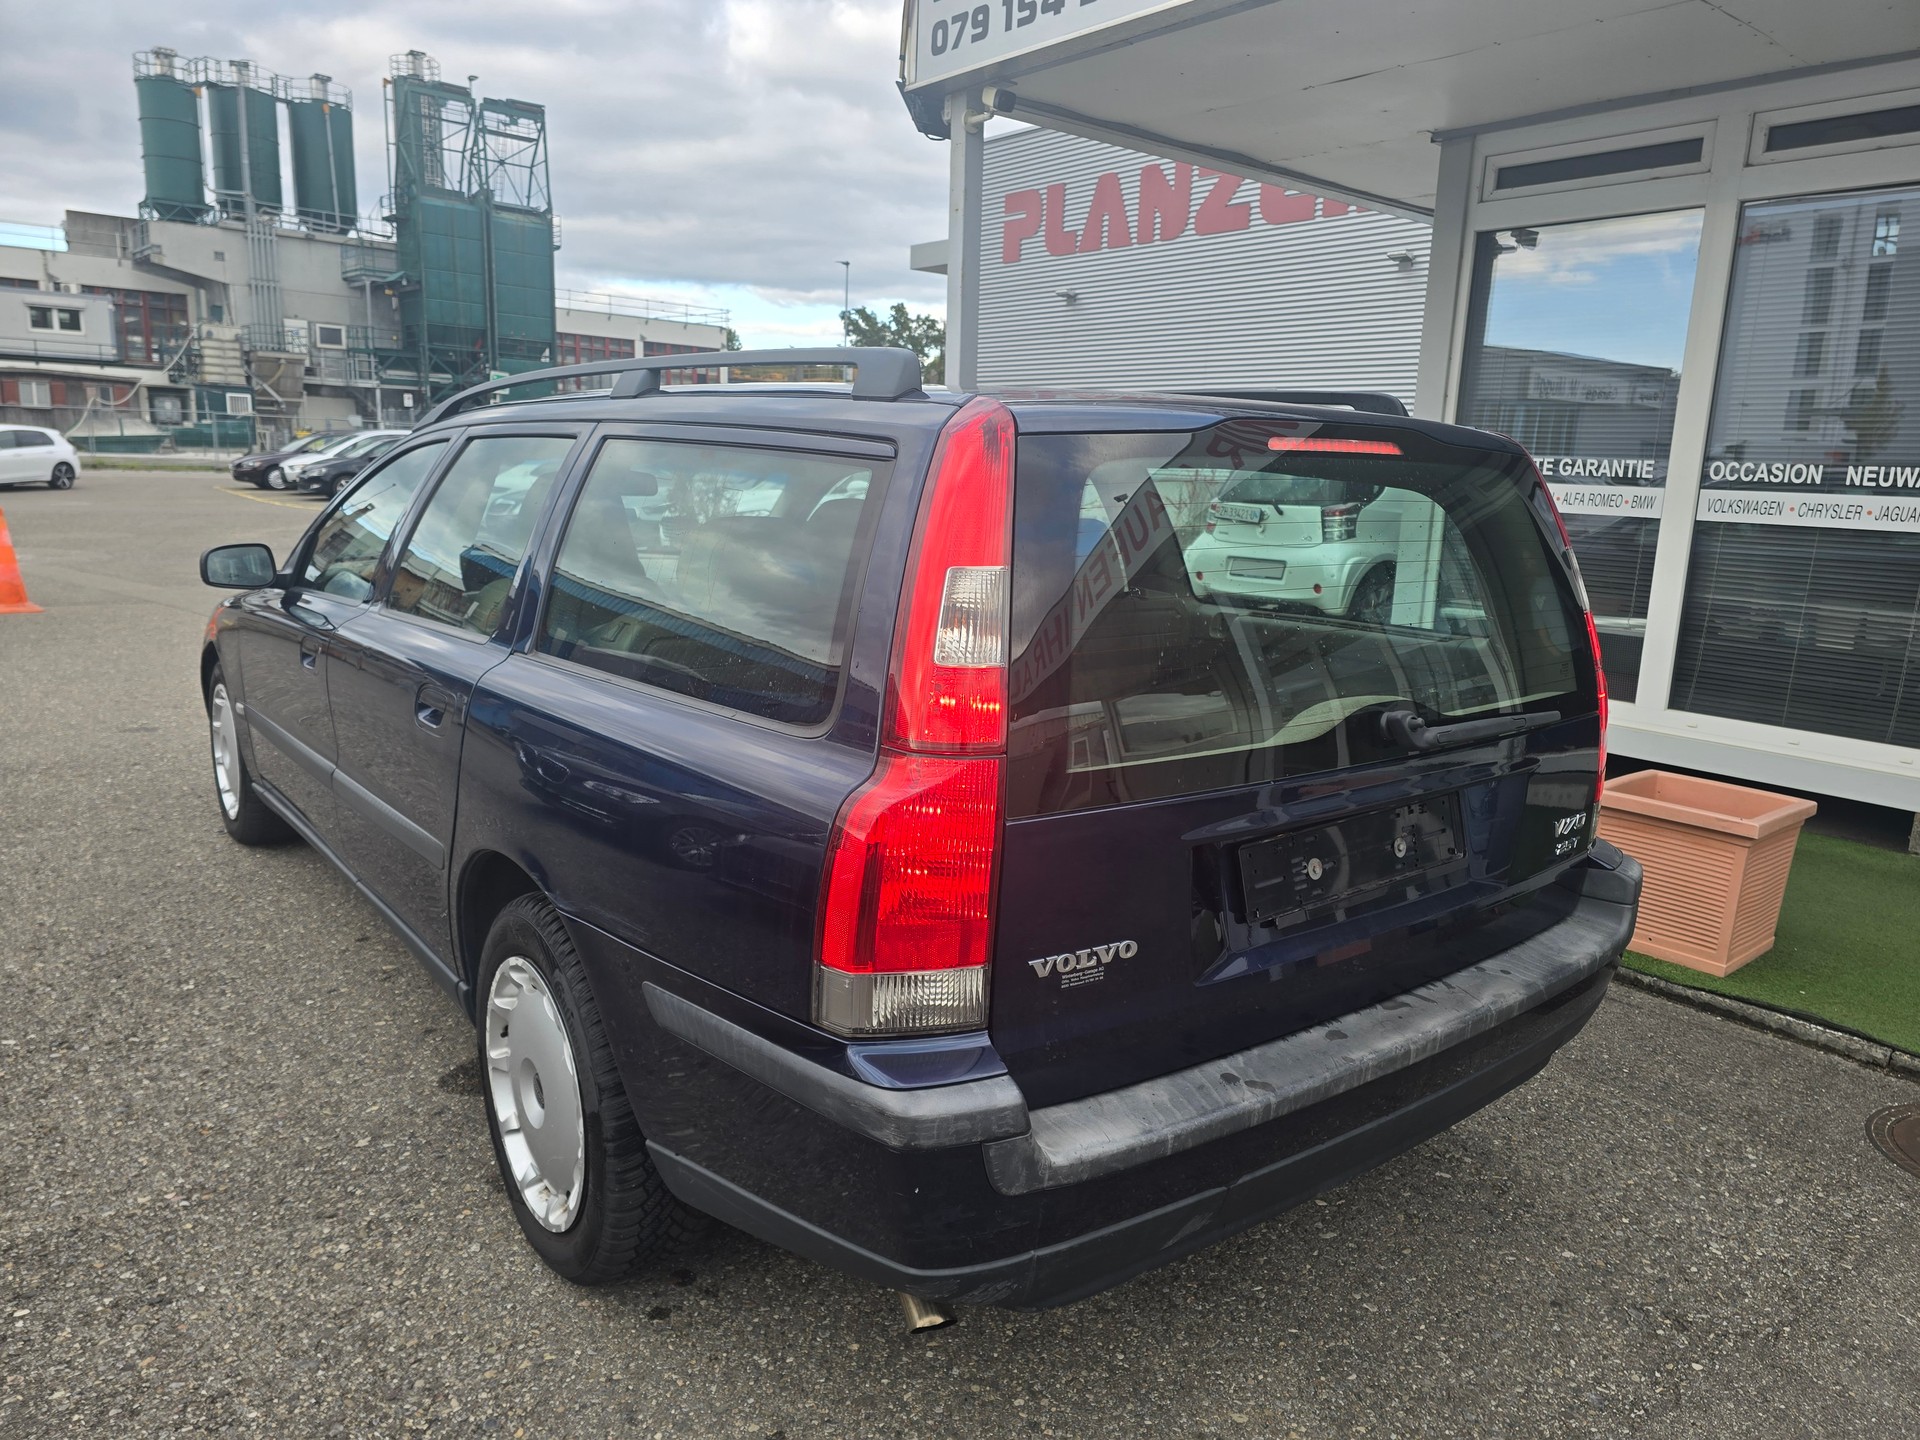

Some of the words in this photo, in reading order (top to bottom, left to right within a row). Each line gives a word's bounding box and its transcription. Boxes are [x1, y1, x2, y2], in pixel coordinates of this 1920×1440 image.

[931, 4, 990, 56] 079
[1559, 458, 1655, 478] GARANTIE
[1709, 461, 1823, 484] OCCASION
[1562, 492, 1585, 506] ALFA
[1587, 493, 1623, 508] ROMEO
[1631, 495, 1656, 509] BMW
[1707, 498, 1785, 516] VOLKSWAGEN
[1797, 502, 1863, 520] CHRYSLER
[1553, 812, 1586, 838] V70
[1028, 940, 1138, 978] VOLVO
